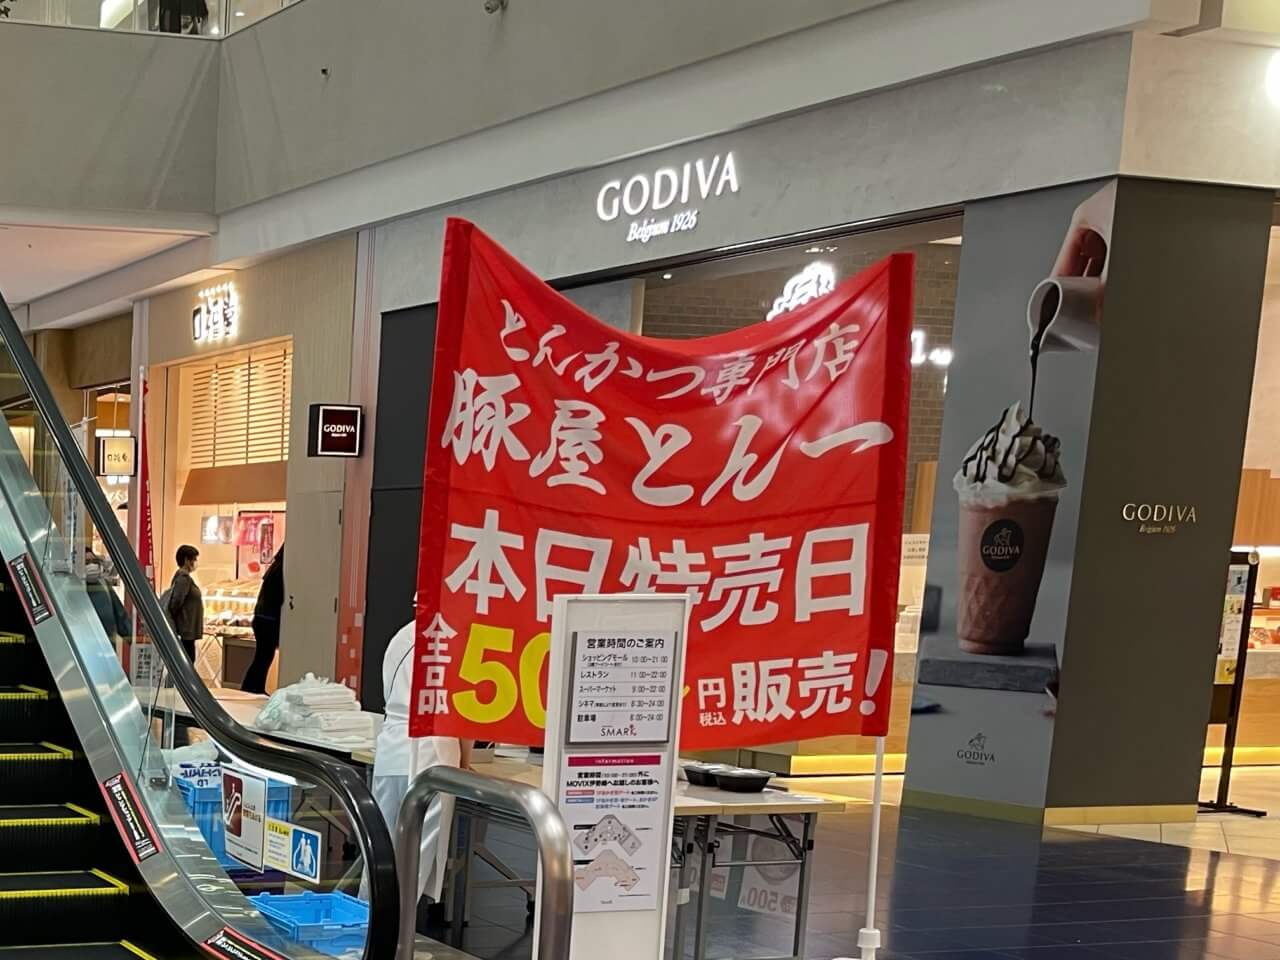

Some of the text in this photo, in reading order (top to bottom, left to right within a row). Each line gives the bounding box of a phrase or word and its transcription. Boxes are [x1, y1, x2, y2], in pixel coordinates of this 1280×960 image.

[596, 151, 739, 221] GODIVA
[626, 209, 698, 243] Belgium 1926
[500, 299, 861, 404] とんかつ専門店
[323, 424, 355, 433] GODIVA
[440, 368, 894, 507] 豚屋とん一
[1122, 503, 1196, 523] GODIVA
[982, 545, 1020, 556] GODIVA
[445, 509, 870, 632] 本日特売日
[587, 638, 664, 649] 営業時間のご案内
[417, 612, 458, 715] 全品
[582, 654, 628, 662] ショッピングモール
[580, 671, 609, 679] レストラン
[699, 711, 726, 727] 税込
[956, 749, 996, 762] GODIVA
